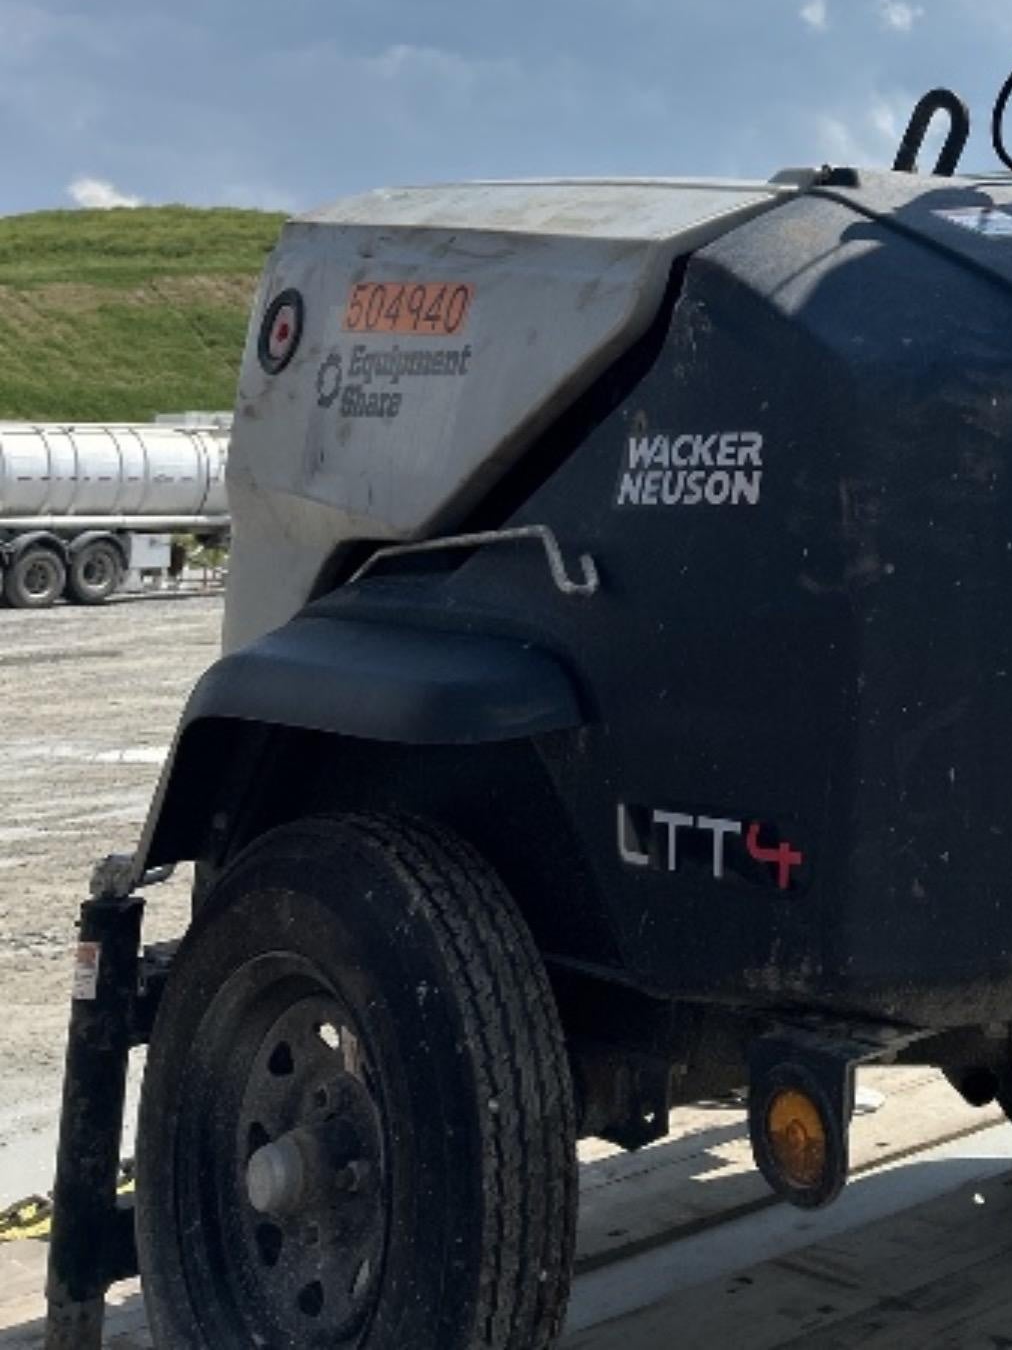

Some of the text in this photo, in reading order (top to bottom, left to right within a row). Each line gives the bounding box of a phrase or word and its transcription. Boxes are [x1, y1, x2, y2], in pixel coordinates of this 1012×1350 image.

[346, 283, 469, 334] 504940
[348, 344, 472, 385] Equipment
[340, 384, 402, 418] Share
[628, 431, 764, 469] WACKER
[616, 470, 764, 505] NEUSON
[617, 802, 804, 890] LTT4
